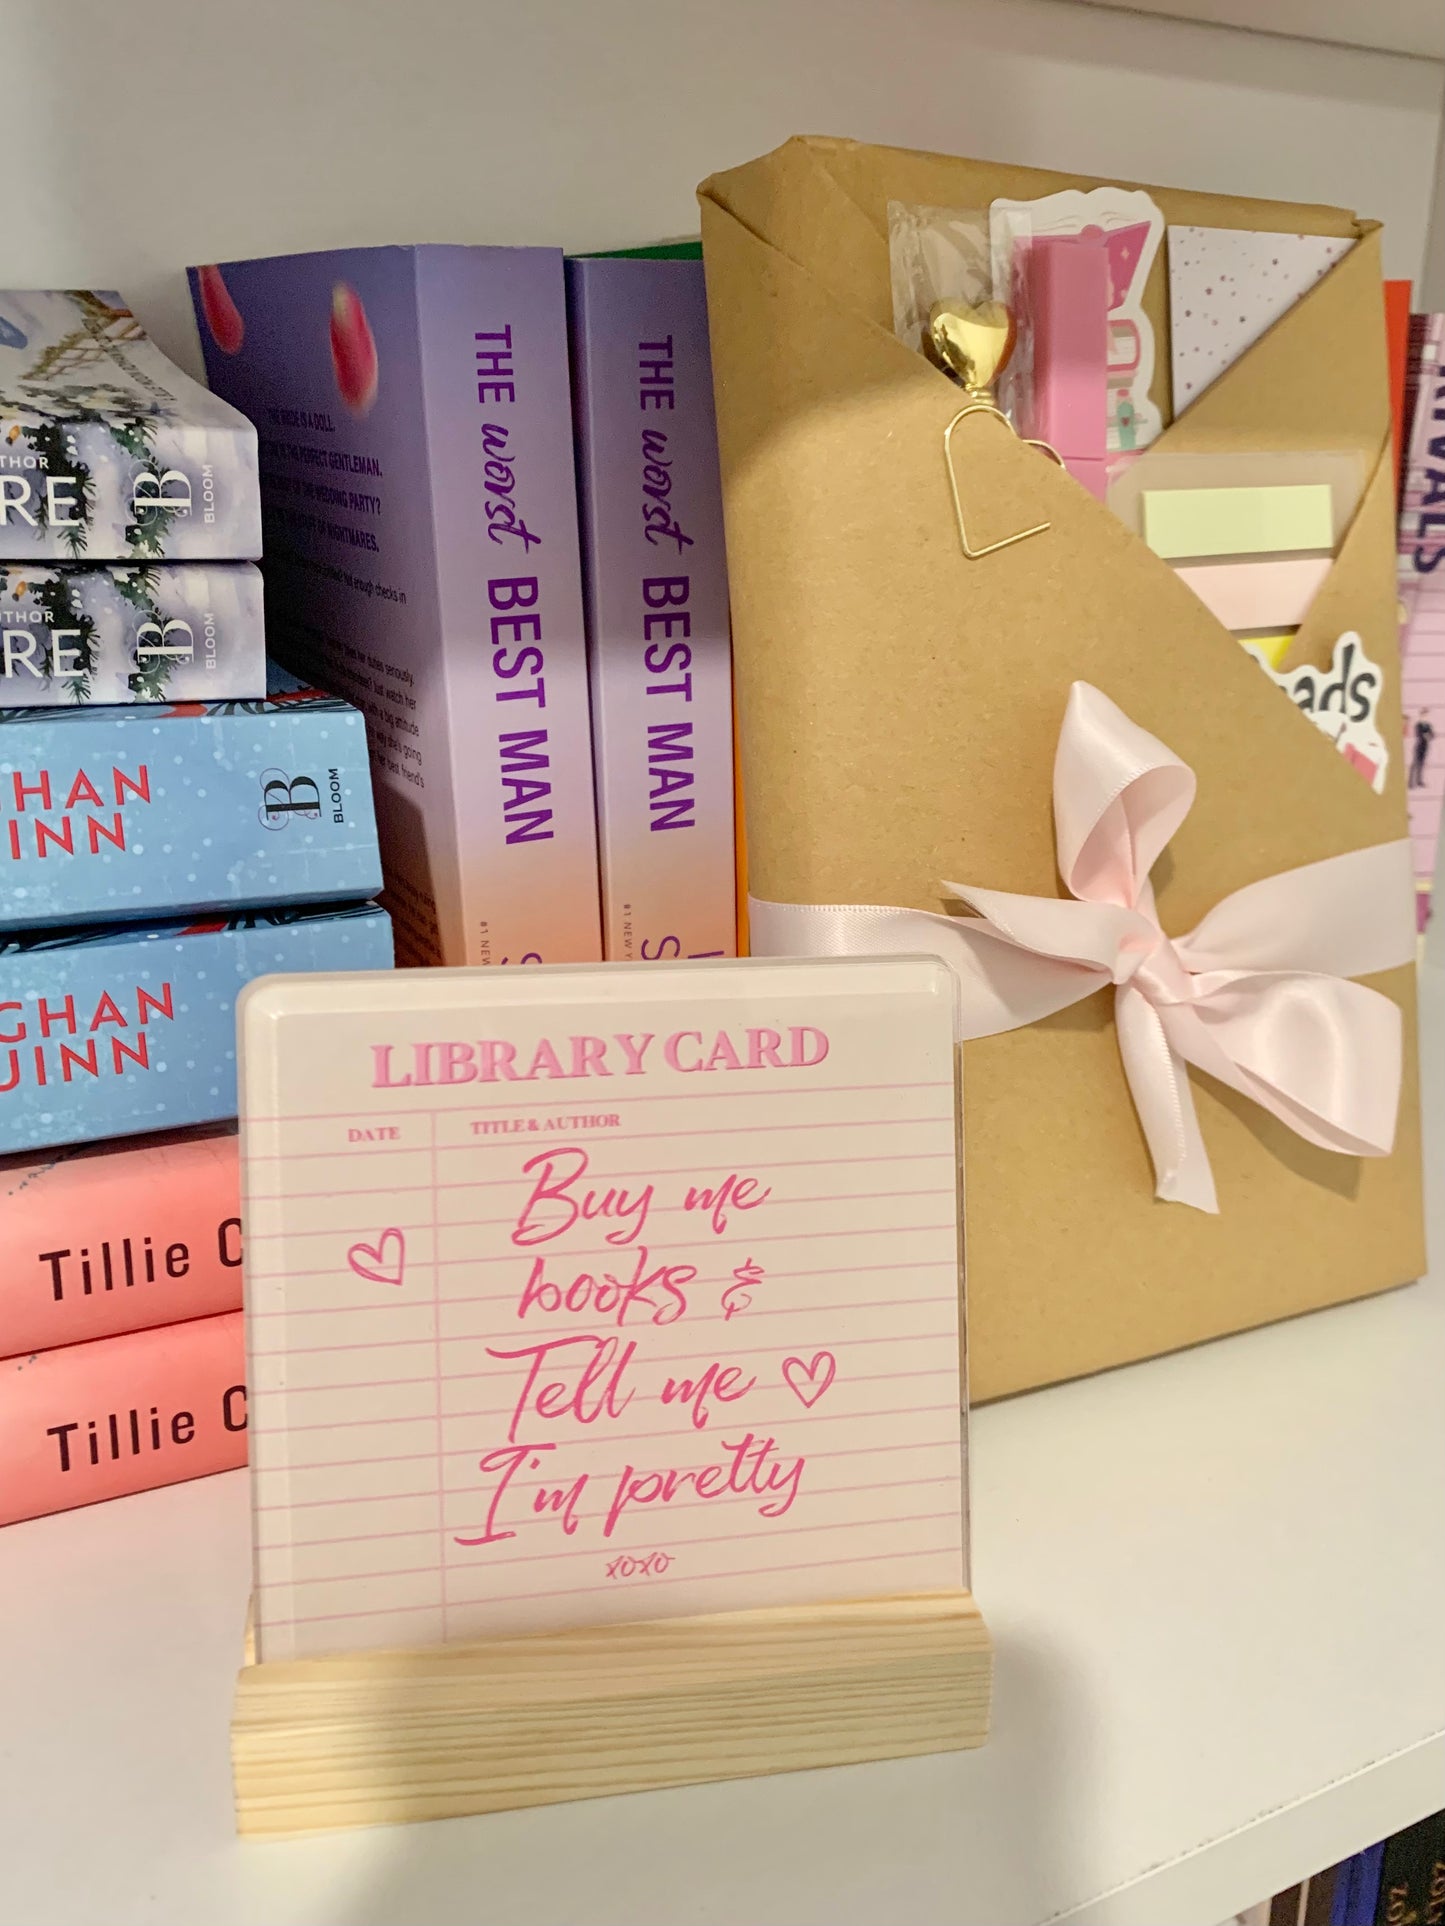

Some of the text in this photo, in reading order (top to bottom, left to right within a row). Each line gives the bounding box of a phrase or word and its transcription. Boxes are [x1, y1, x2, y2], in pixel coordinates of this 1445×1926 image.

[314, 413, 336, 432] DOLL.
[329, 450, 383, 477] GENTLEMAN.
[0, 475, 80, 526] RE
[204, 463, 215, 523] BLOOM
[349, 492, 381, 515] PARTY?
[328, 521, 379, 552] NIGHTMARES.
[474, 324, 554, 845] THE worst BEST MAN
[638, 334, 696, 832] THE worst BEST MAN
[0, 610, 54, 624] THOR
[205, 612, 216, 670] BLOOM
[2, 629, 83, 678] RE
[1279, 643, 1377, 721] ads
[12, 764, 151, 811] HAN
[328, 767, 344, 824] BLOOM
[8, 812, 126, 860] INN
[623, 921, 633, 955] NEW
[370, 1026, 830, 1089] LIBRARY CARD
[348, 1126, 400, 1143] DATE
[470, 1119, 526, 1135] TITLE
[543, 1113, 621, 1132] AUTHOR
[511, 1147, 772, 1246] Buy me
[38, 1236, 190, 1301] Tillie
[518, 1246, 766, 1327] books &
[485, 1335, 757, 1443] Tell me
[46, 1406, 195, 1472] Tillie
[454, 1433, 805, 1546] I'm pretty
[606, 1551, 675, 1581] xoxo
